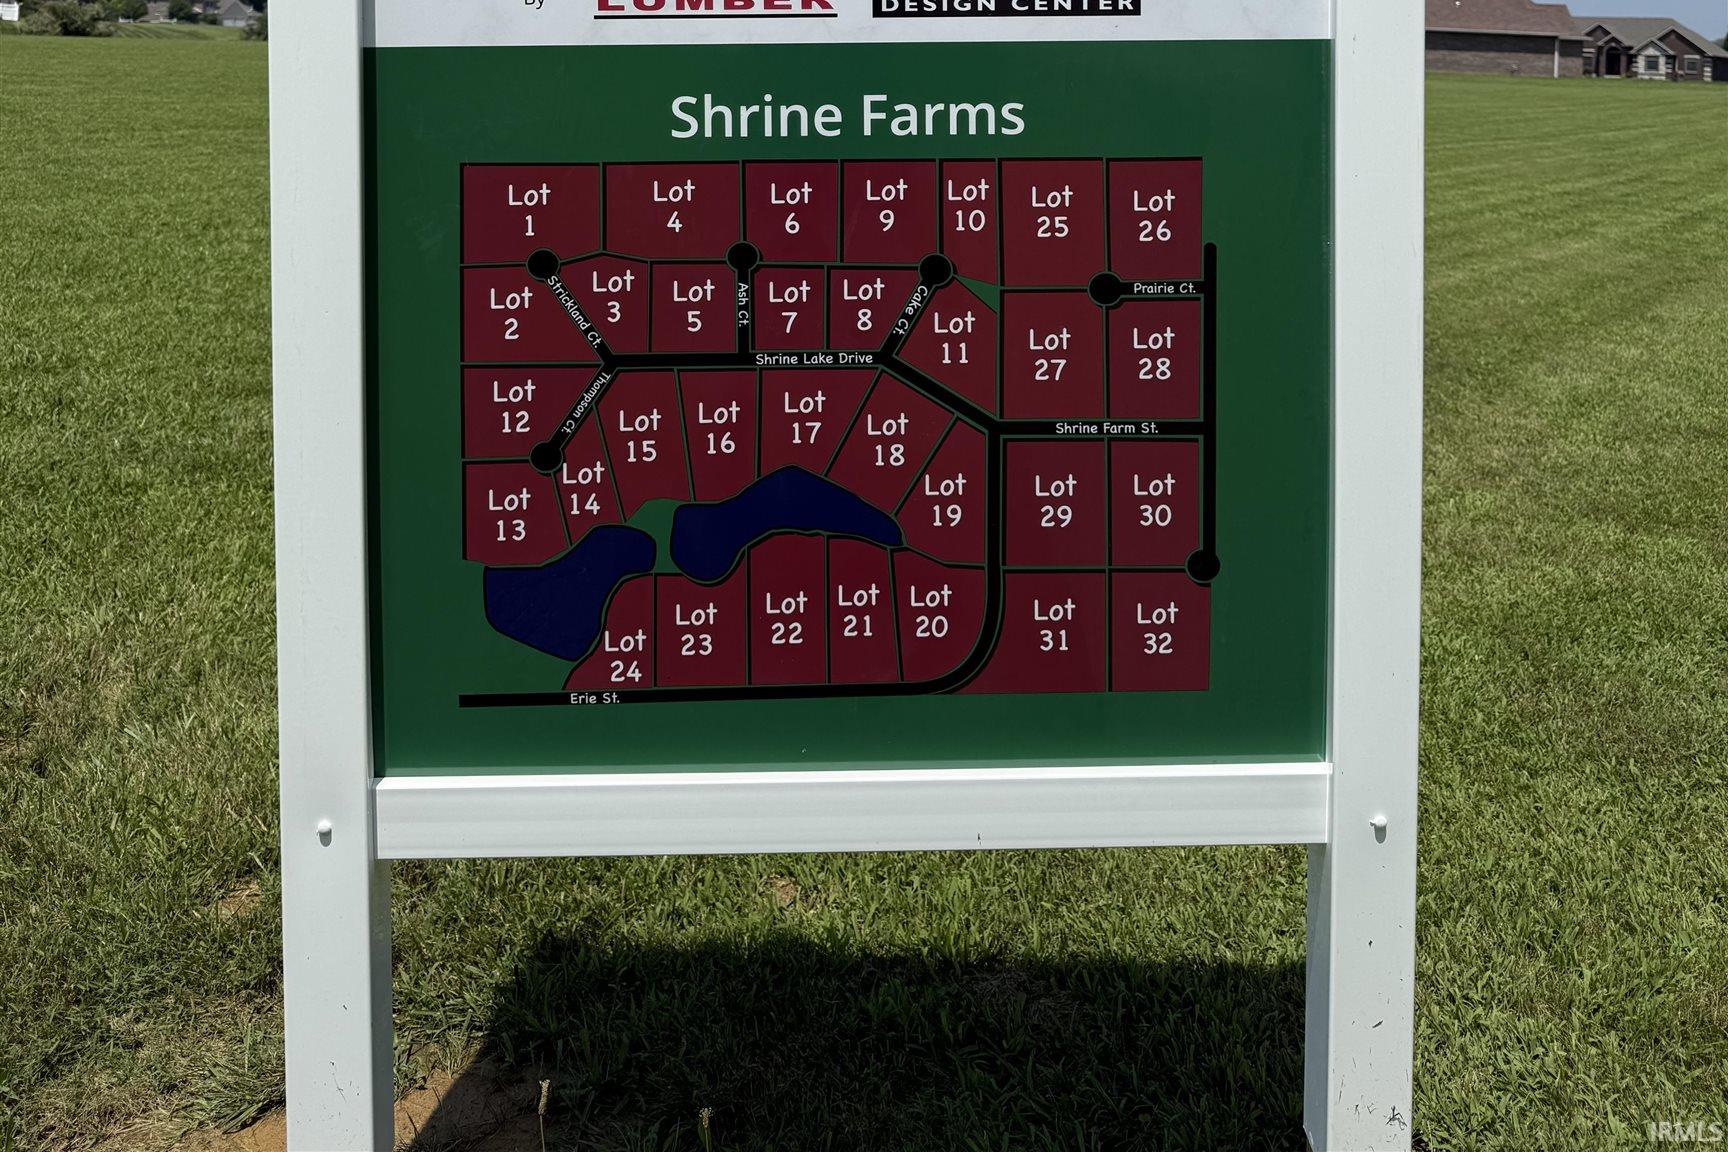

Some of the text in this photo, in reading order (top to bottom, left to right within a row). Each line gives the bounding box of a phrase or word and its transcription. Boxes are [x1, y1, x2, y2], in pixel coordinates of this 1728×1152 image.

[672, 94, 1024, 138] Shrine Farms
[509, 183, 550, 206] Lot
[654, 180, 695, 202] Lot
[772, 182, 812, 204] Lot
[867, 179, 907, 201] Lot
[948, 179, 989, 201] Lot
[1032, 185, 1073, 207] Lot
[1134, 190, 1175, 211] Lot
[526, 215, 534, 236] 1
[667, 211, 682, 232] 4
[785, 213, 799, 233] 6
[880, 210, 894, 231] 9
[956, 210, 985, 231] 10
[1038, 216, 1068, 237] 25
[1139, 220, 1171, 241] 26
[593, 270, 634, 292] Lot
[674, 279, 715, 302] Lot
[770, 280, 810, 303] Lot
[844, 278, 884, 300] Lot
[1134, 283, 1196, 293] Prairie Ct.
[491, 287, 532, 309] Lot
[738, 283, 749, 327] Ash Ct.
[548, 276, 601, 348] Strickland Ct.
[608, 301, 620, 322] 3
[688, 311, 701, 332] 5
[858, 309, 872, 330] 8
[893, 286, 928, 335] Cake Ct.
[505, 318, 519, 339] 2
[782, 312, 797, 333] 7
[935, 311, 975, 333] Lot
[1030, 328, 1071, 350] Lot
[1134, 327, 1175, 349] Lot
[756, 352, 873, 365] Shrine Lake Drive
[943, 343, 968, 363] 11
[1035, 359, 1066, 380] 27
[1139, 358, 1171, 380] 28
[494, 380, 536, 402] Lot
[785, 391, 826, 413] Lot
[561, 372, 611, 433] Thompson Ct.
[699, 401, 740, 423] Lot
[503, 411, 530, 432] 12
[620, 409, 661, 431] Lot
[868, 413, 908, 435] Lot
[1056, 423, 1158, 434] Shrine Farm St.
[708, 432, 735, 454] 16
[793, 422, 821, 443] 17
[628, 441, 656, 462] 15
[876, 444, 904, 466] 18
[563, 461, 604, 484] Lot
[926, 473, 966, 496] Lot
[1036, 474, 1077, 496] Lot
[1134, 474, 1175, 495] Lot
[489, 488, 531, 511] Lot
[571, 493, 600, 514] 14
[934, 505, 961, 526] 19
[1041, 506, 1072, 527] 29
[1140, 505, 1171, 526] 30
[497, 520, 525, 541] 13
[767, 591, 807, 614] Lot
[839, 584, 880, 606] Lot
[911, 584, 952, 607] Lot
[676, 603, 717, 625] Lot
[1035, 599, 1075, 621] Lot
[1138, 602, 1178, 624] Lot
[772, 622, 802, 644] 22
[844, 615, 872, 636] 21
[916, 616, 948, 637] 20
[605, 629, 646, 652] Lot
[682, 634, 712, 655] 23
[1041, 630, 1068, 650] 31
[1144, 633, 1172, 654] 32
[611, 661, 641, 682] 24
[570, 692, 620, 704] Erie St.
